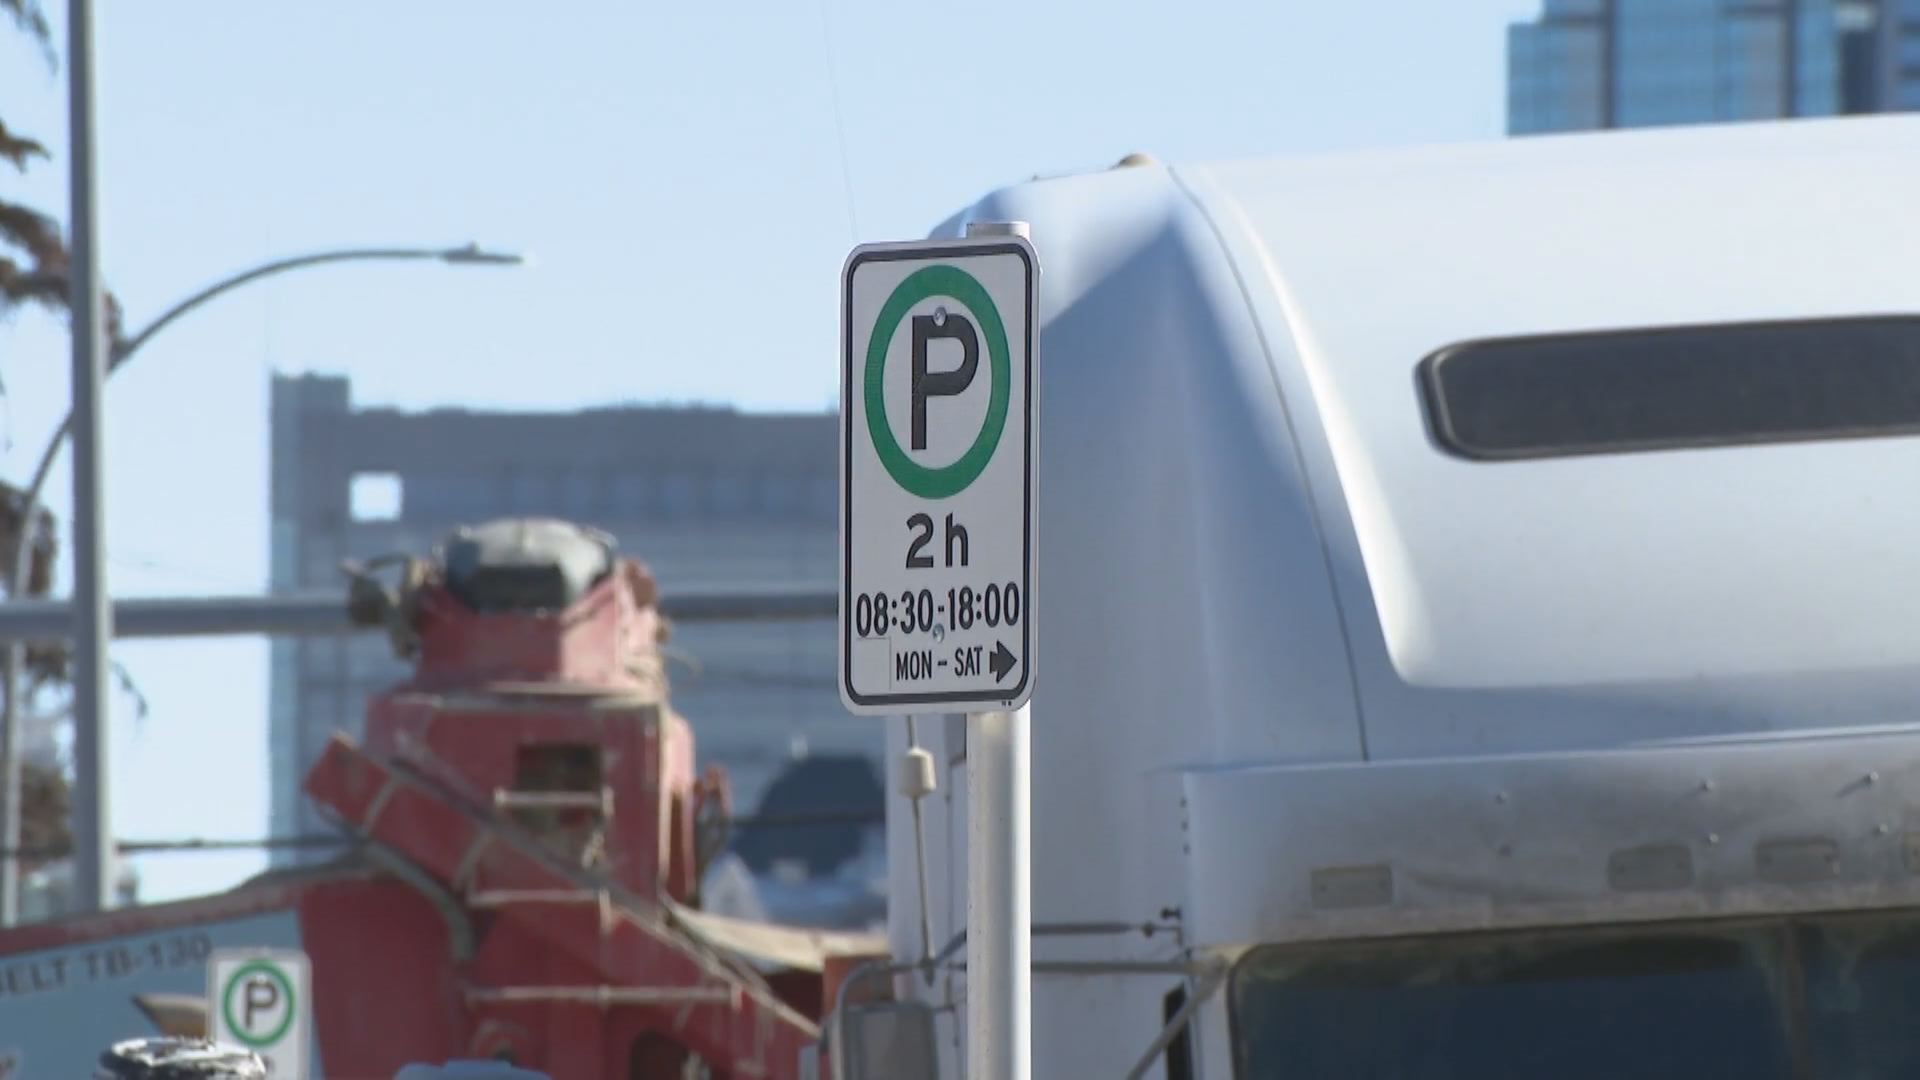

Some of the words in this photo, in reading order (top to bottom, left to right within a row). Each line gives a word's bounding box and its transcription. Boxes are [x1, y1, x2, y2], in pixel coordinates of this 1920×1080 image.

[912, 313, 979, 450] P
[896, 651, 932, 681] MON
[954, 646, 983, 677] SAT
[0, 957, 67, 994] ELT
[244, 980, 278, 1029] P
